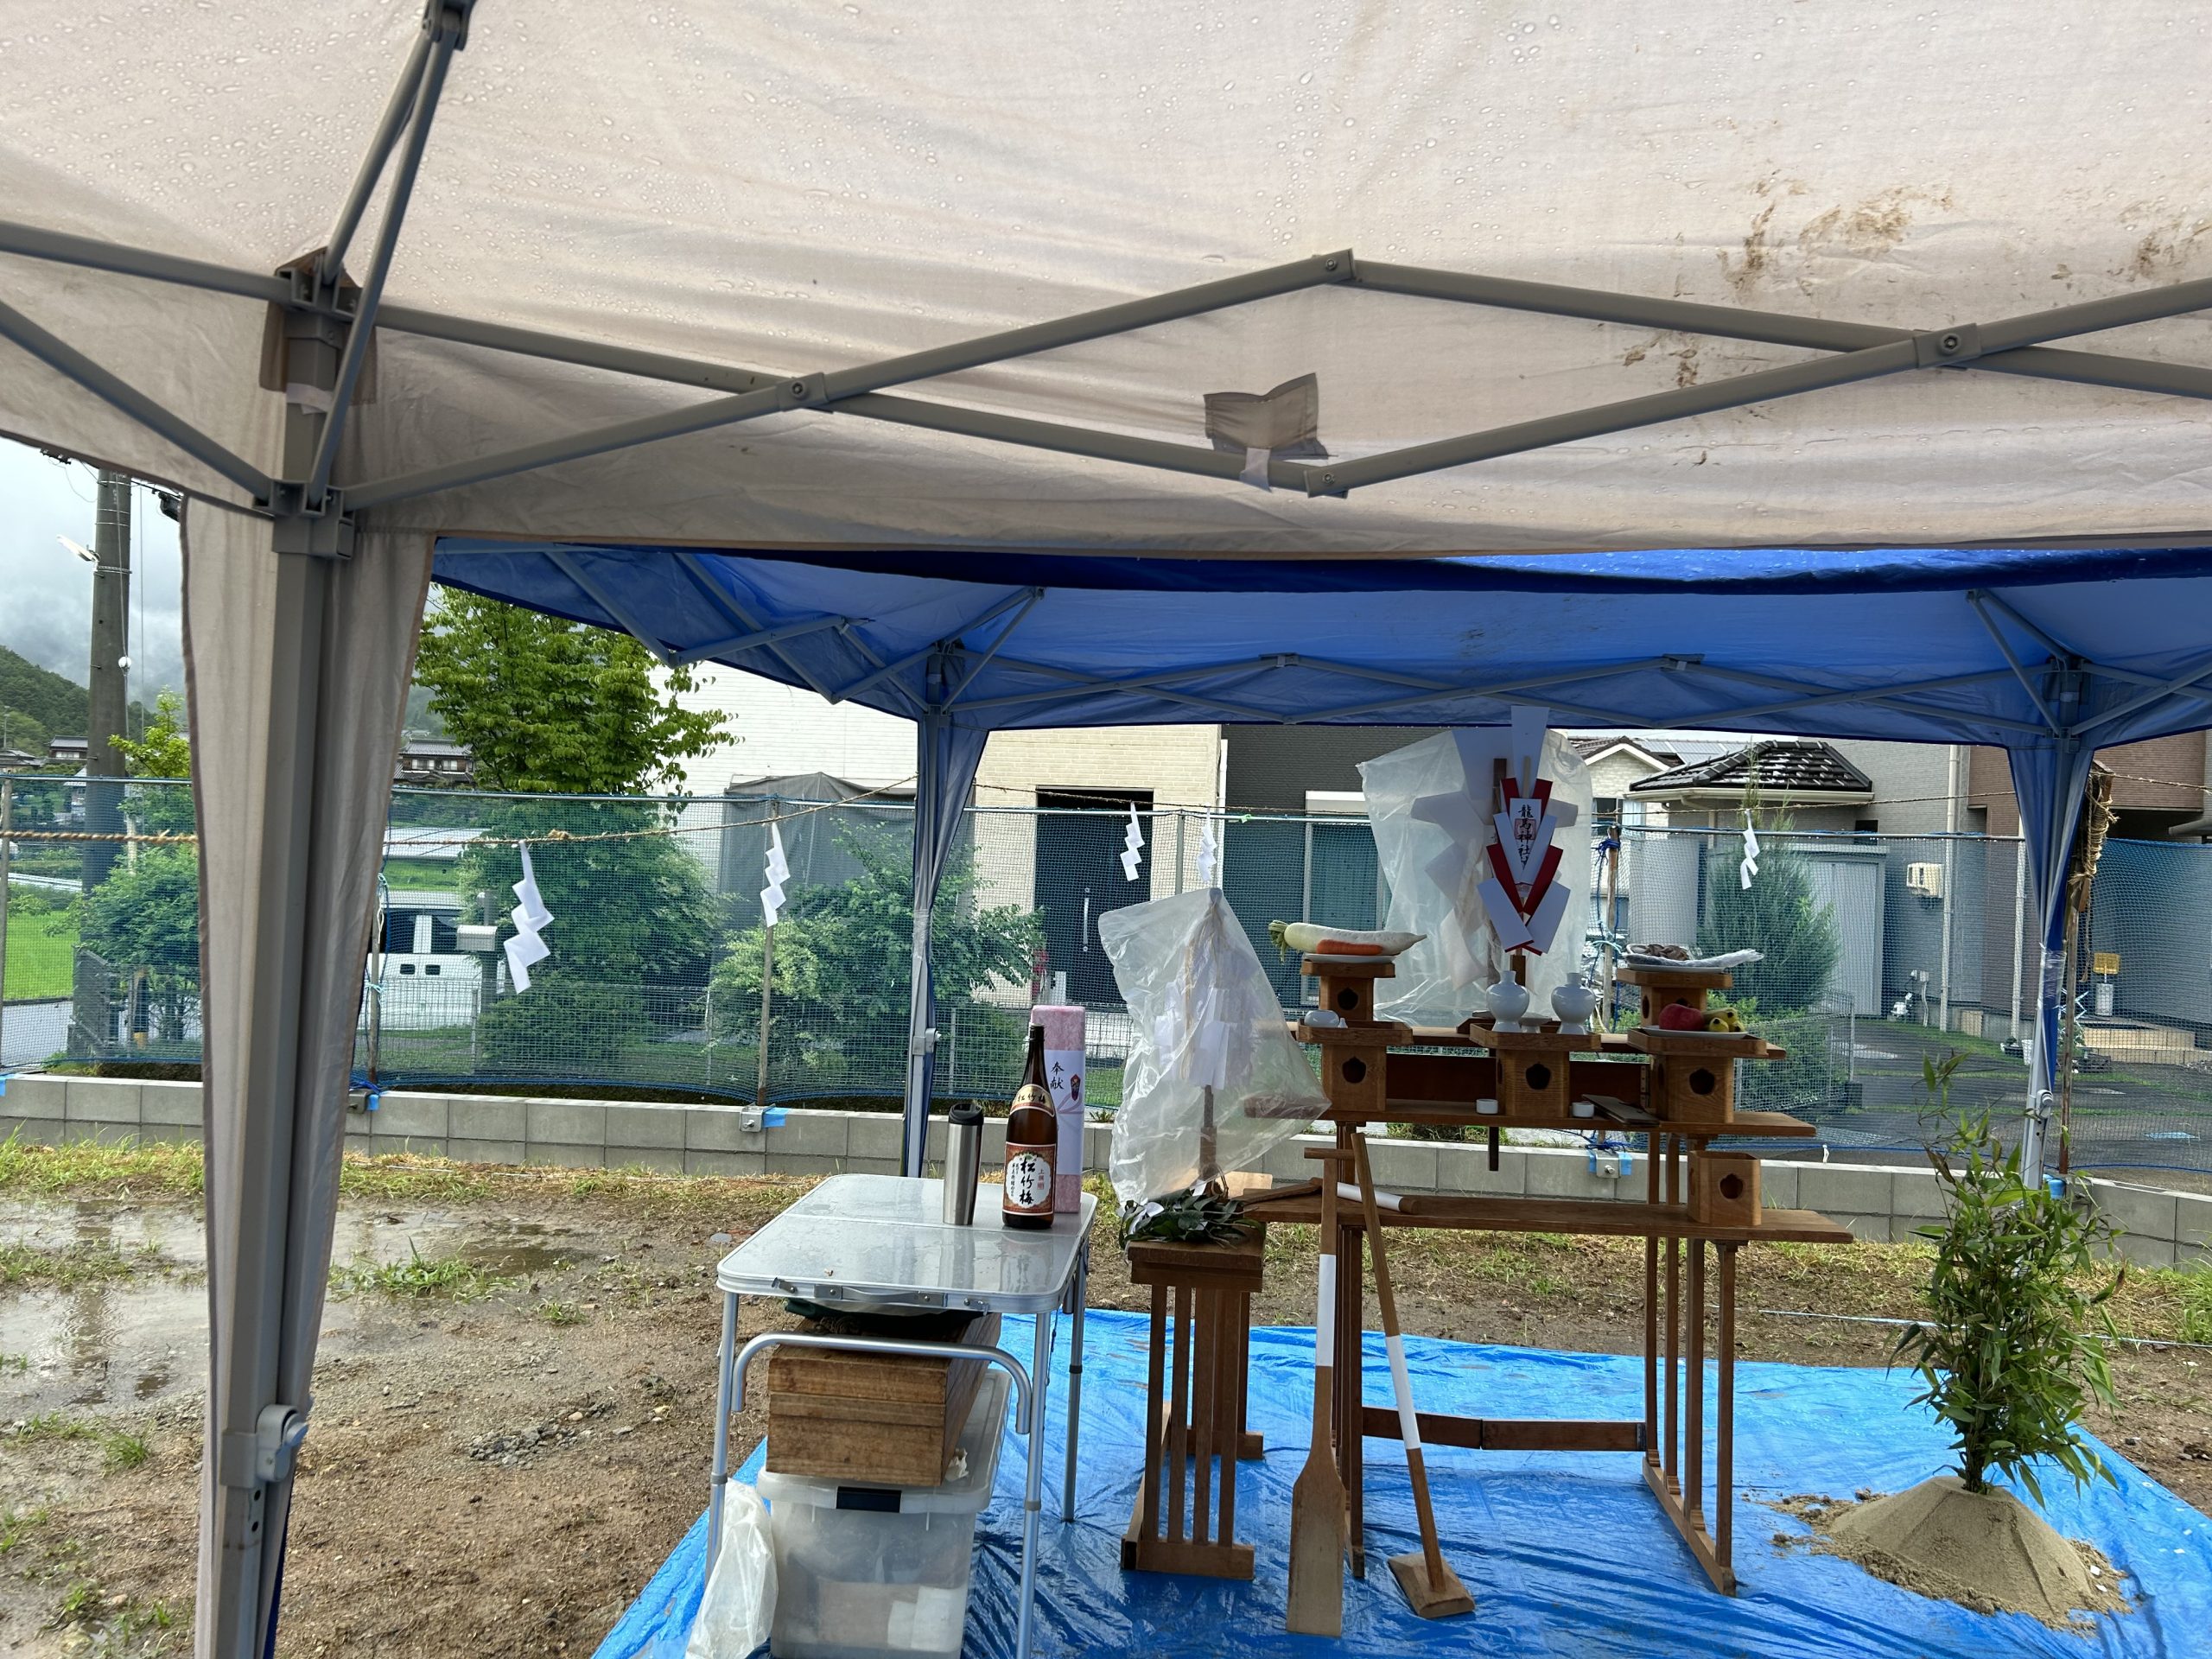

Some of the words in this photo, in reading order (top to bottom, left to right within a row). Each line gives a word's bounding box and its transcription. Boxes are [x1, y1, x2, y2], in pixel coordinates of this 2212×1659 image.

[1050, 1061, 1065, 1090] 奉献
[1017, 1092, 1046, 1104] 松竹梅
[1019, 1156, 1036, 1205] 松竹梅
